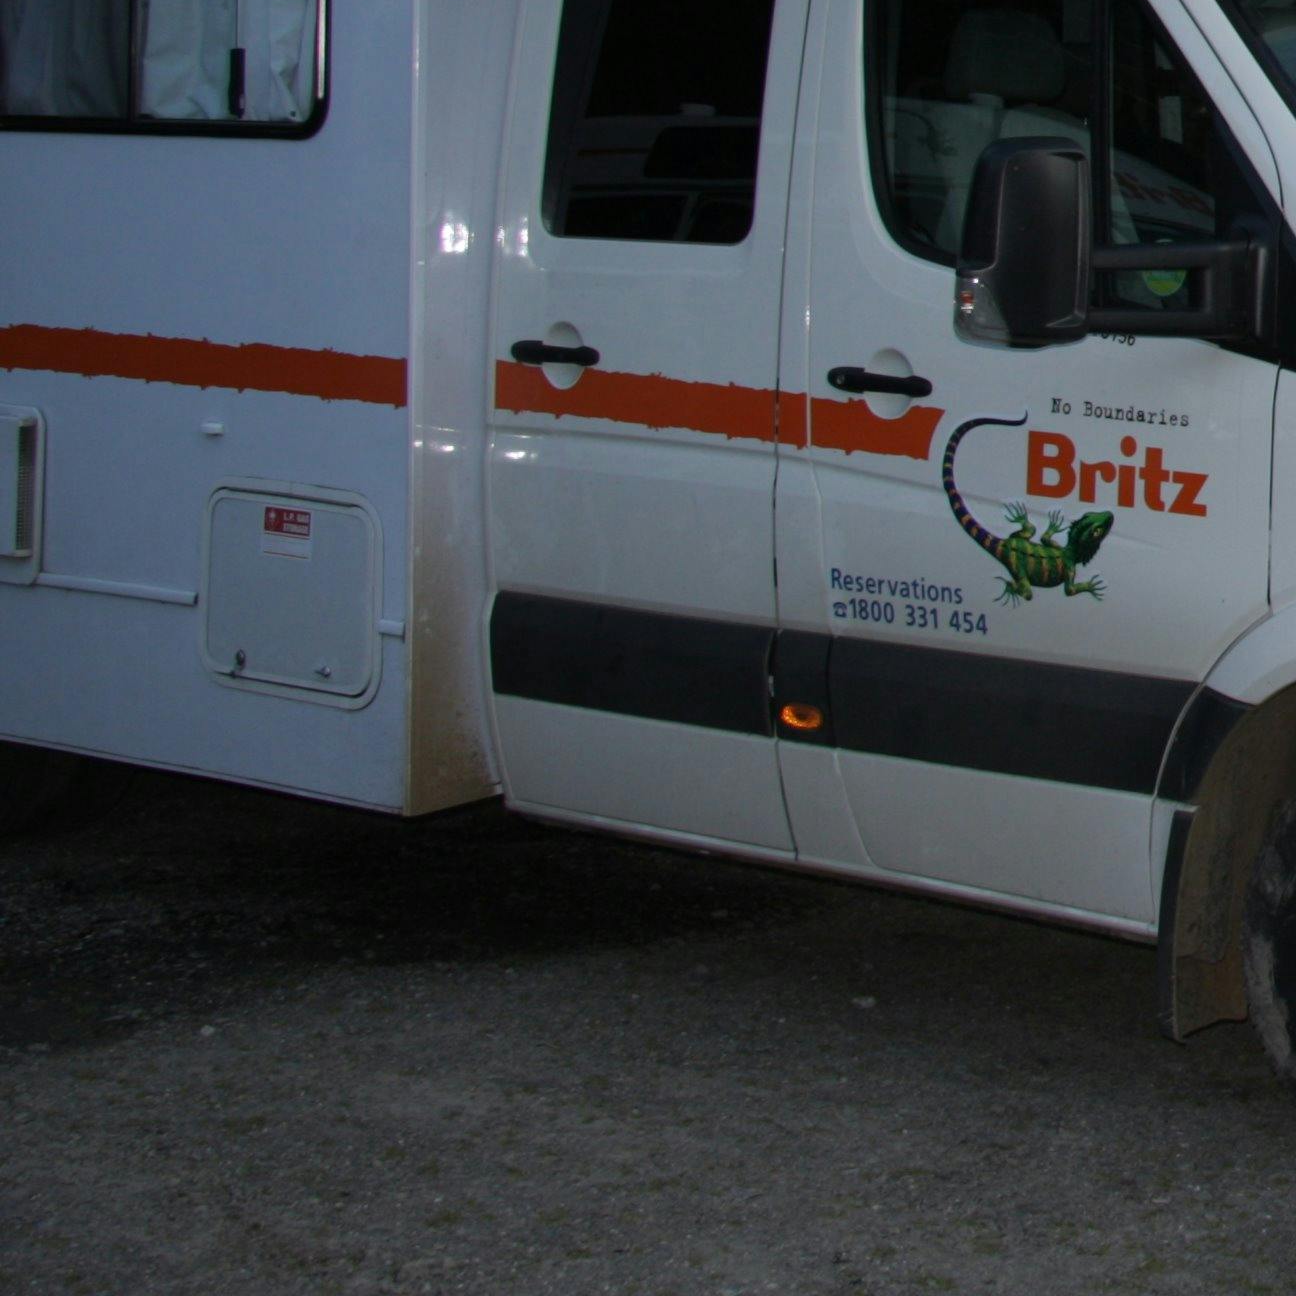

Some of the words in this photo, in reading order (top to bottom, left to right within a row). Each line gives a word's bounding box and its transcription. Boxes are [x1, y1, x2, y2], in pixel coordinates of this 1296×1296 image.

[1051, 397, 1072, 415] No
[1083, 401, 1190, 427] Boundaries
[1026, 430, 1209, 518] Britz
[831, 568, 964, 605] Reservations
[848, 598, 895, 625] 1800
[905, 604, 938, 630] 331
[949, 609, 988, 635] 454
